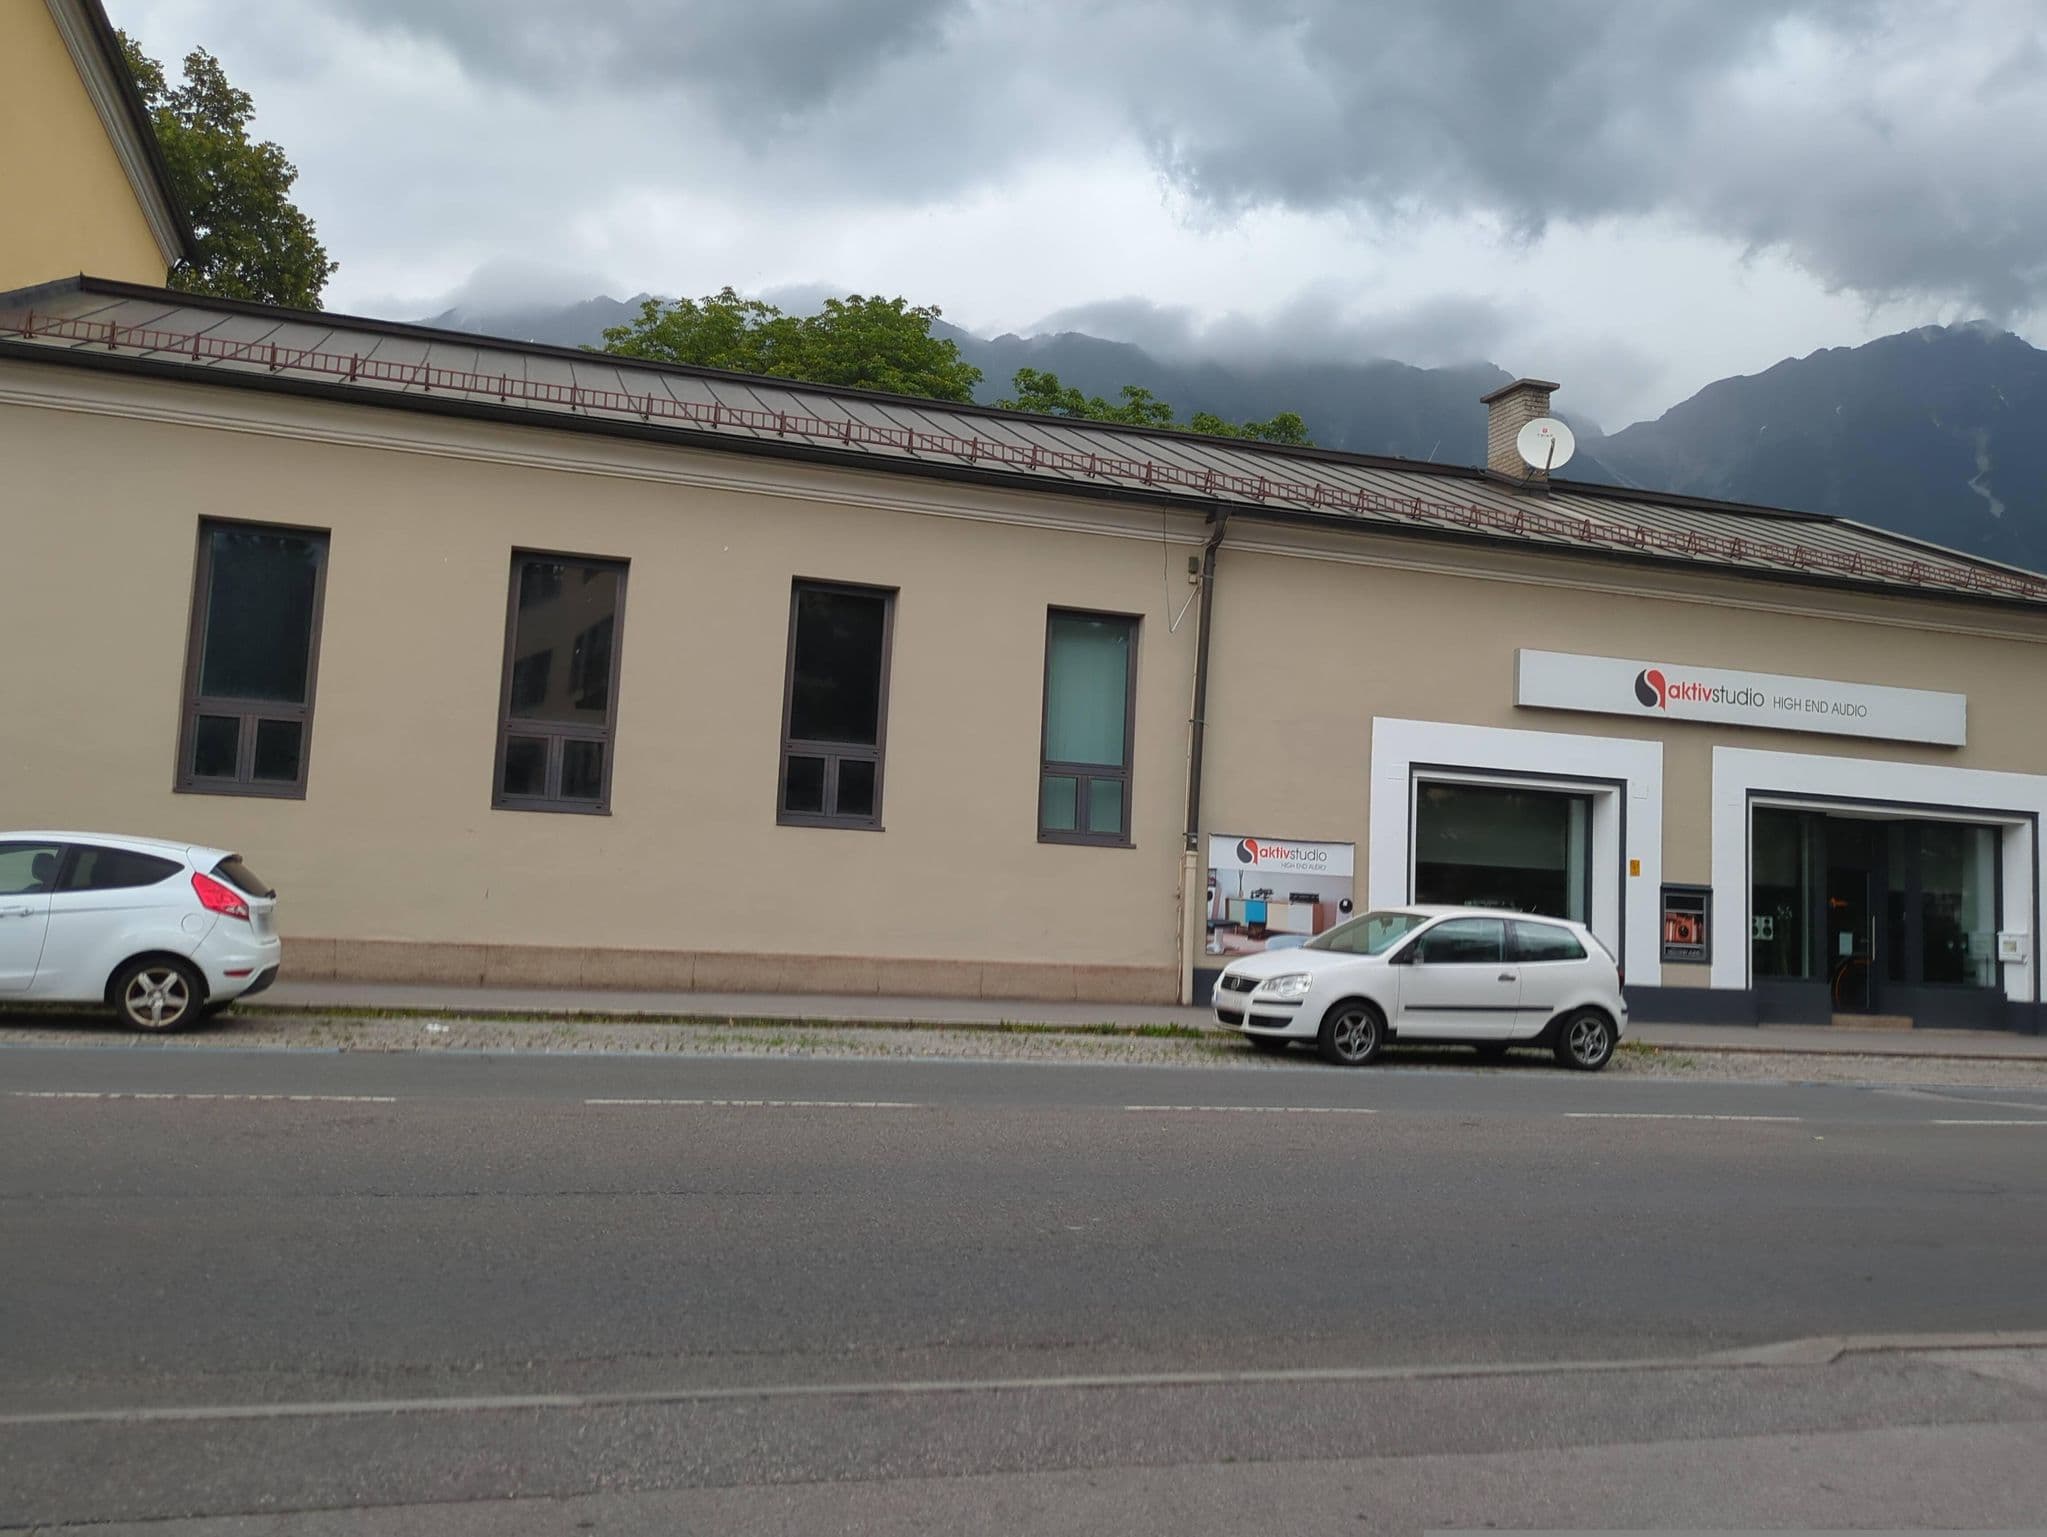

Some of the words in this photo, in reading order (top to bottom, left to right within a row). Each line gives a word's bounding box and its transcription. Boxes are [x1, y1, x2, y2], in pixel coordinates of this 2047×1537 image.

[1668, 682, 1765, 707] aktivstudio
[1773, 696, 1802, 711] HIGH
[1805, 699, 1829, 714] END
[1831, 702, 1867, 718] AUDIO
[1260, 846, 1327, 862] aktivstudio
